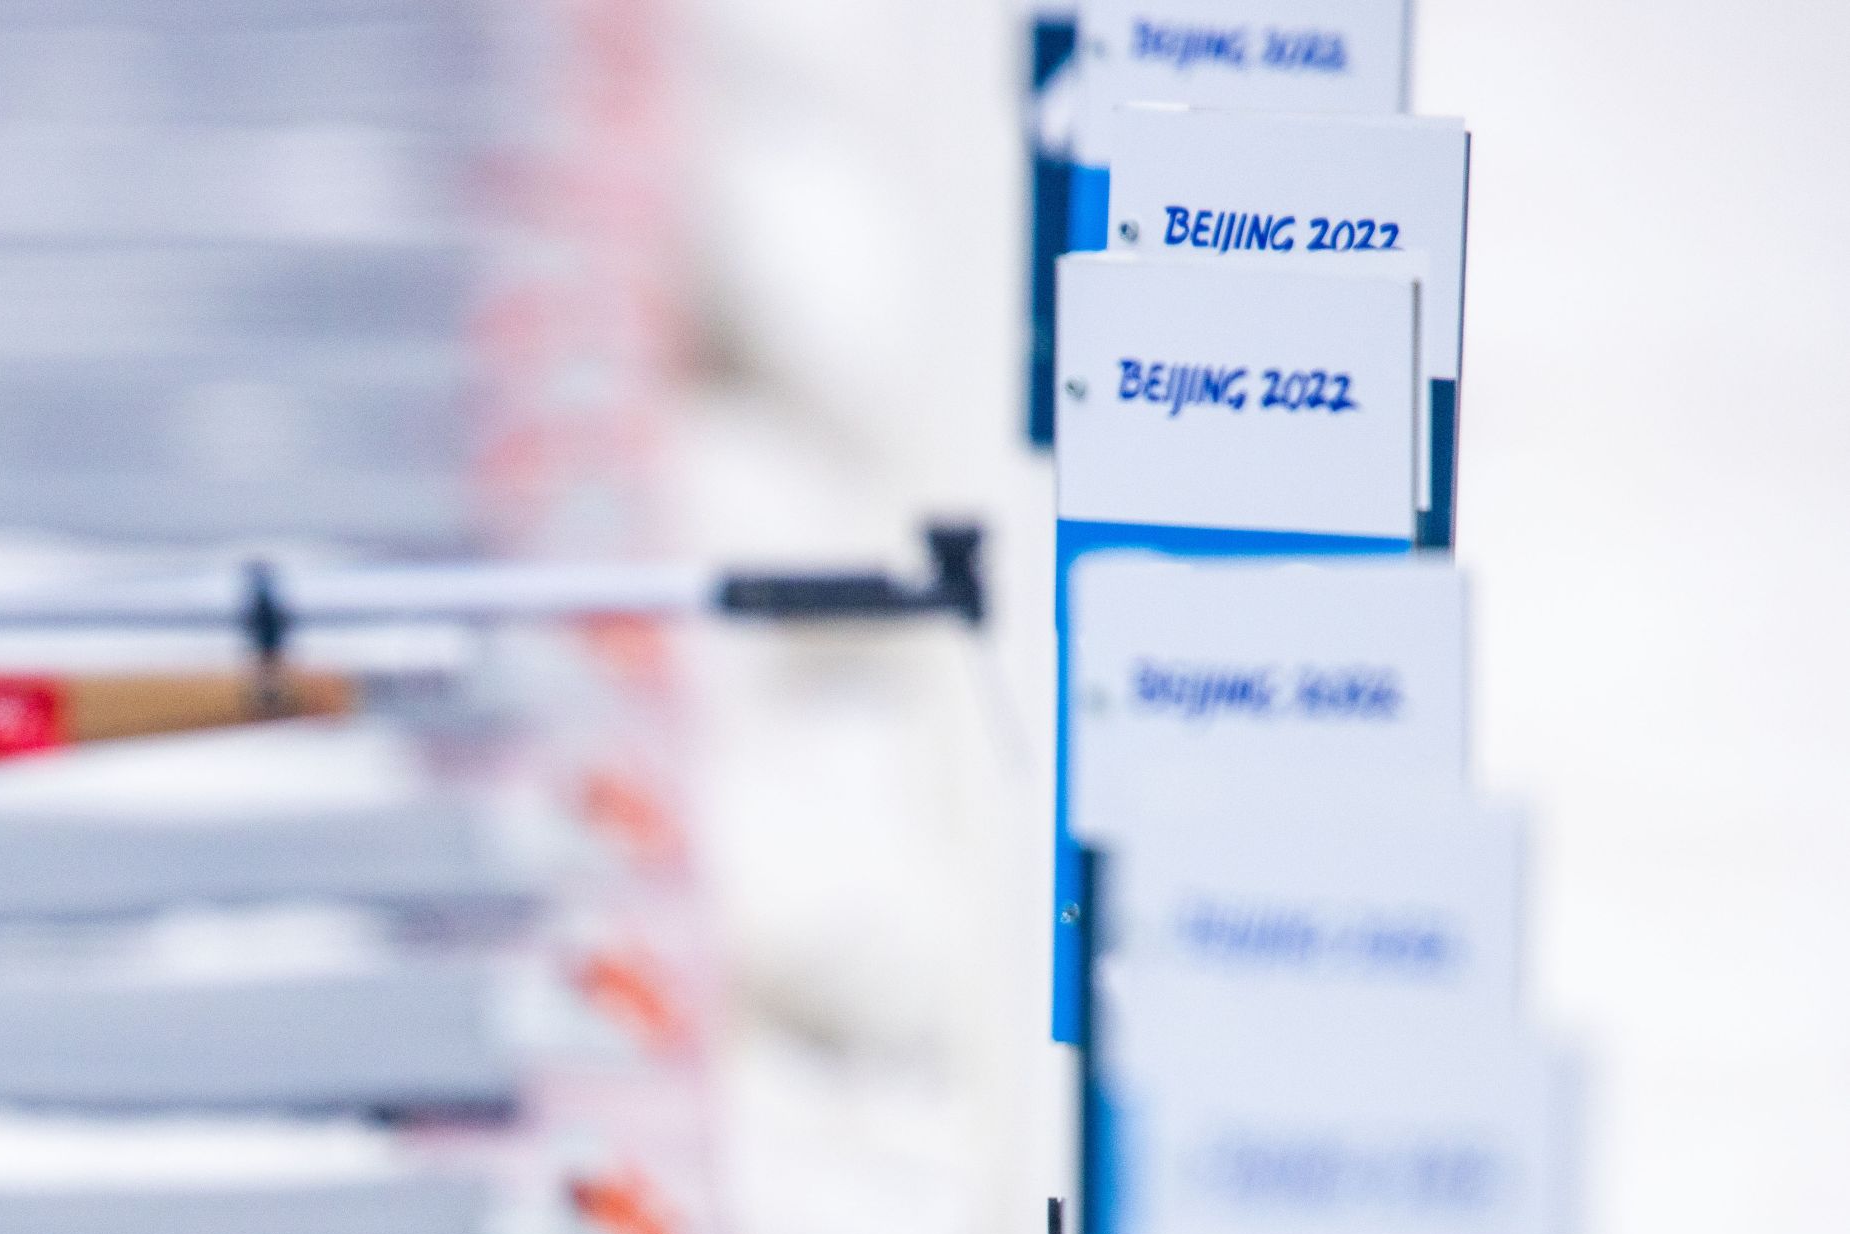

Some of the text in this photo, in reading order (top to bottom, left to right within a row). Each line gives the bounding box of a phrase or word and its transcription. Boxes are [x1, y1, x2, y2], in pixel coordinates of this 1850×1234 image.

[1164, 205, 1403, 255] BEIJING 2022
[1117, 359, 1360, 418] BEIJING 2022
